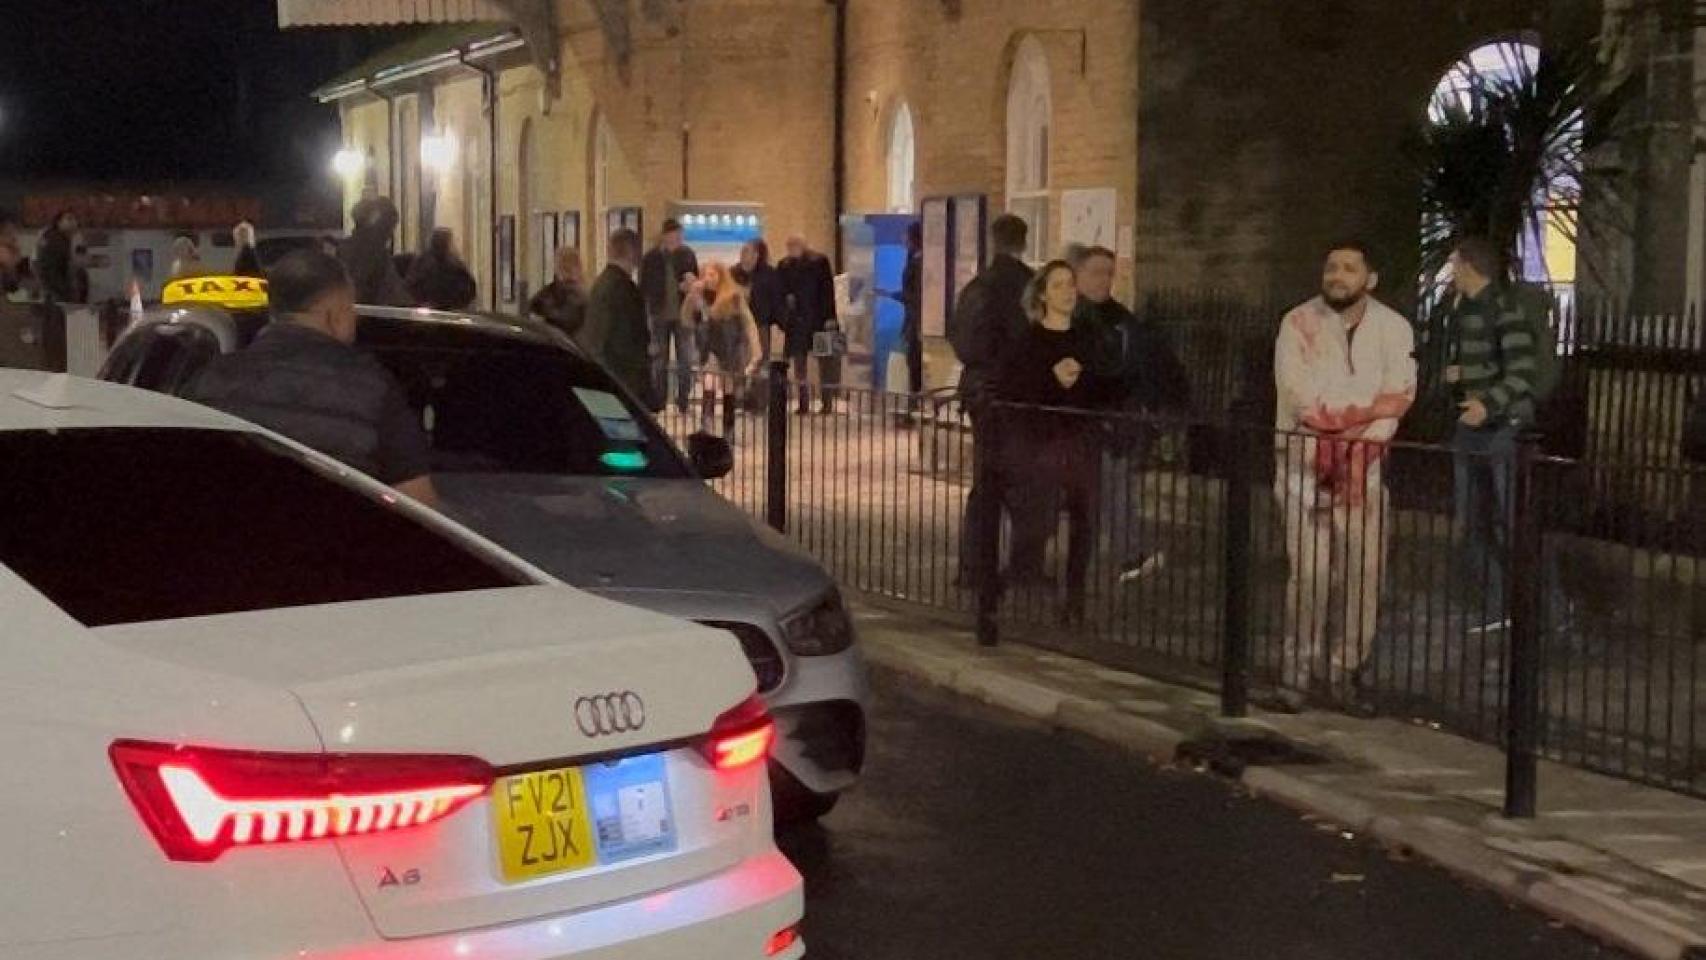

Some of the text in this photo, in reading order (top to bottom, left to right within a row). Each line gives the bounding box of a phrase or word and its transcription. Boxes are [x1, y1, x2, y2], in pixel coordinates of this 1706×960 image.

[177, 280, 268, 295] TAXI
[507, 772, 575, 820] FV21
[517, 817, 580, 866] ZJX
